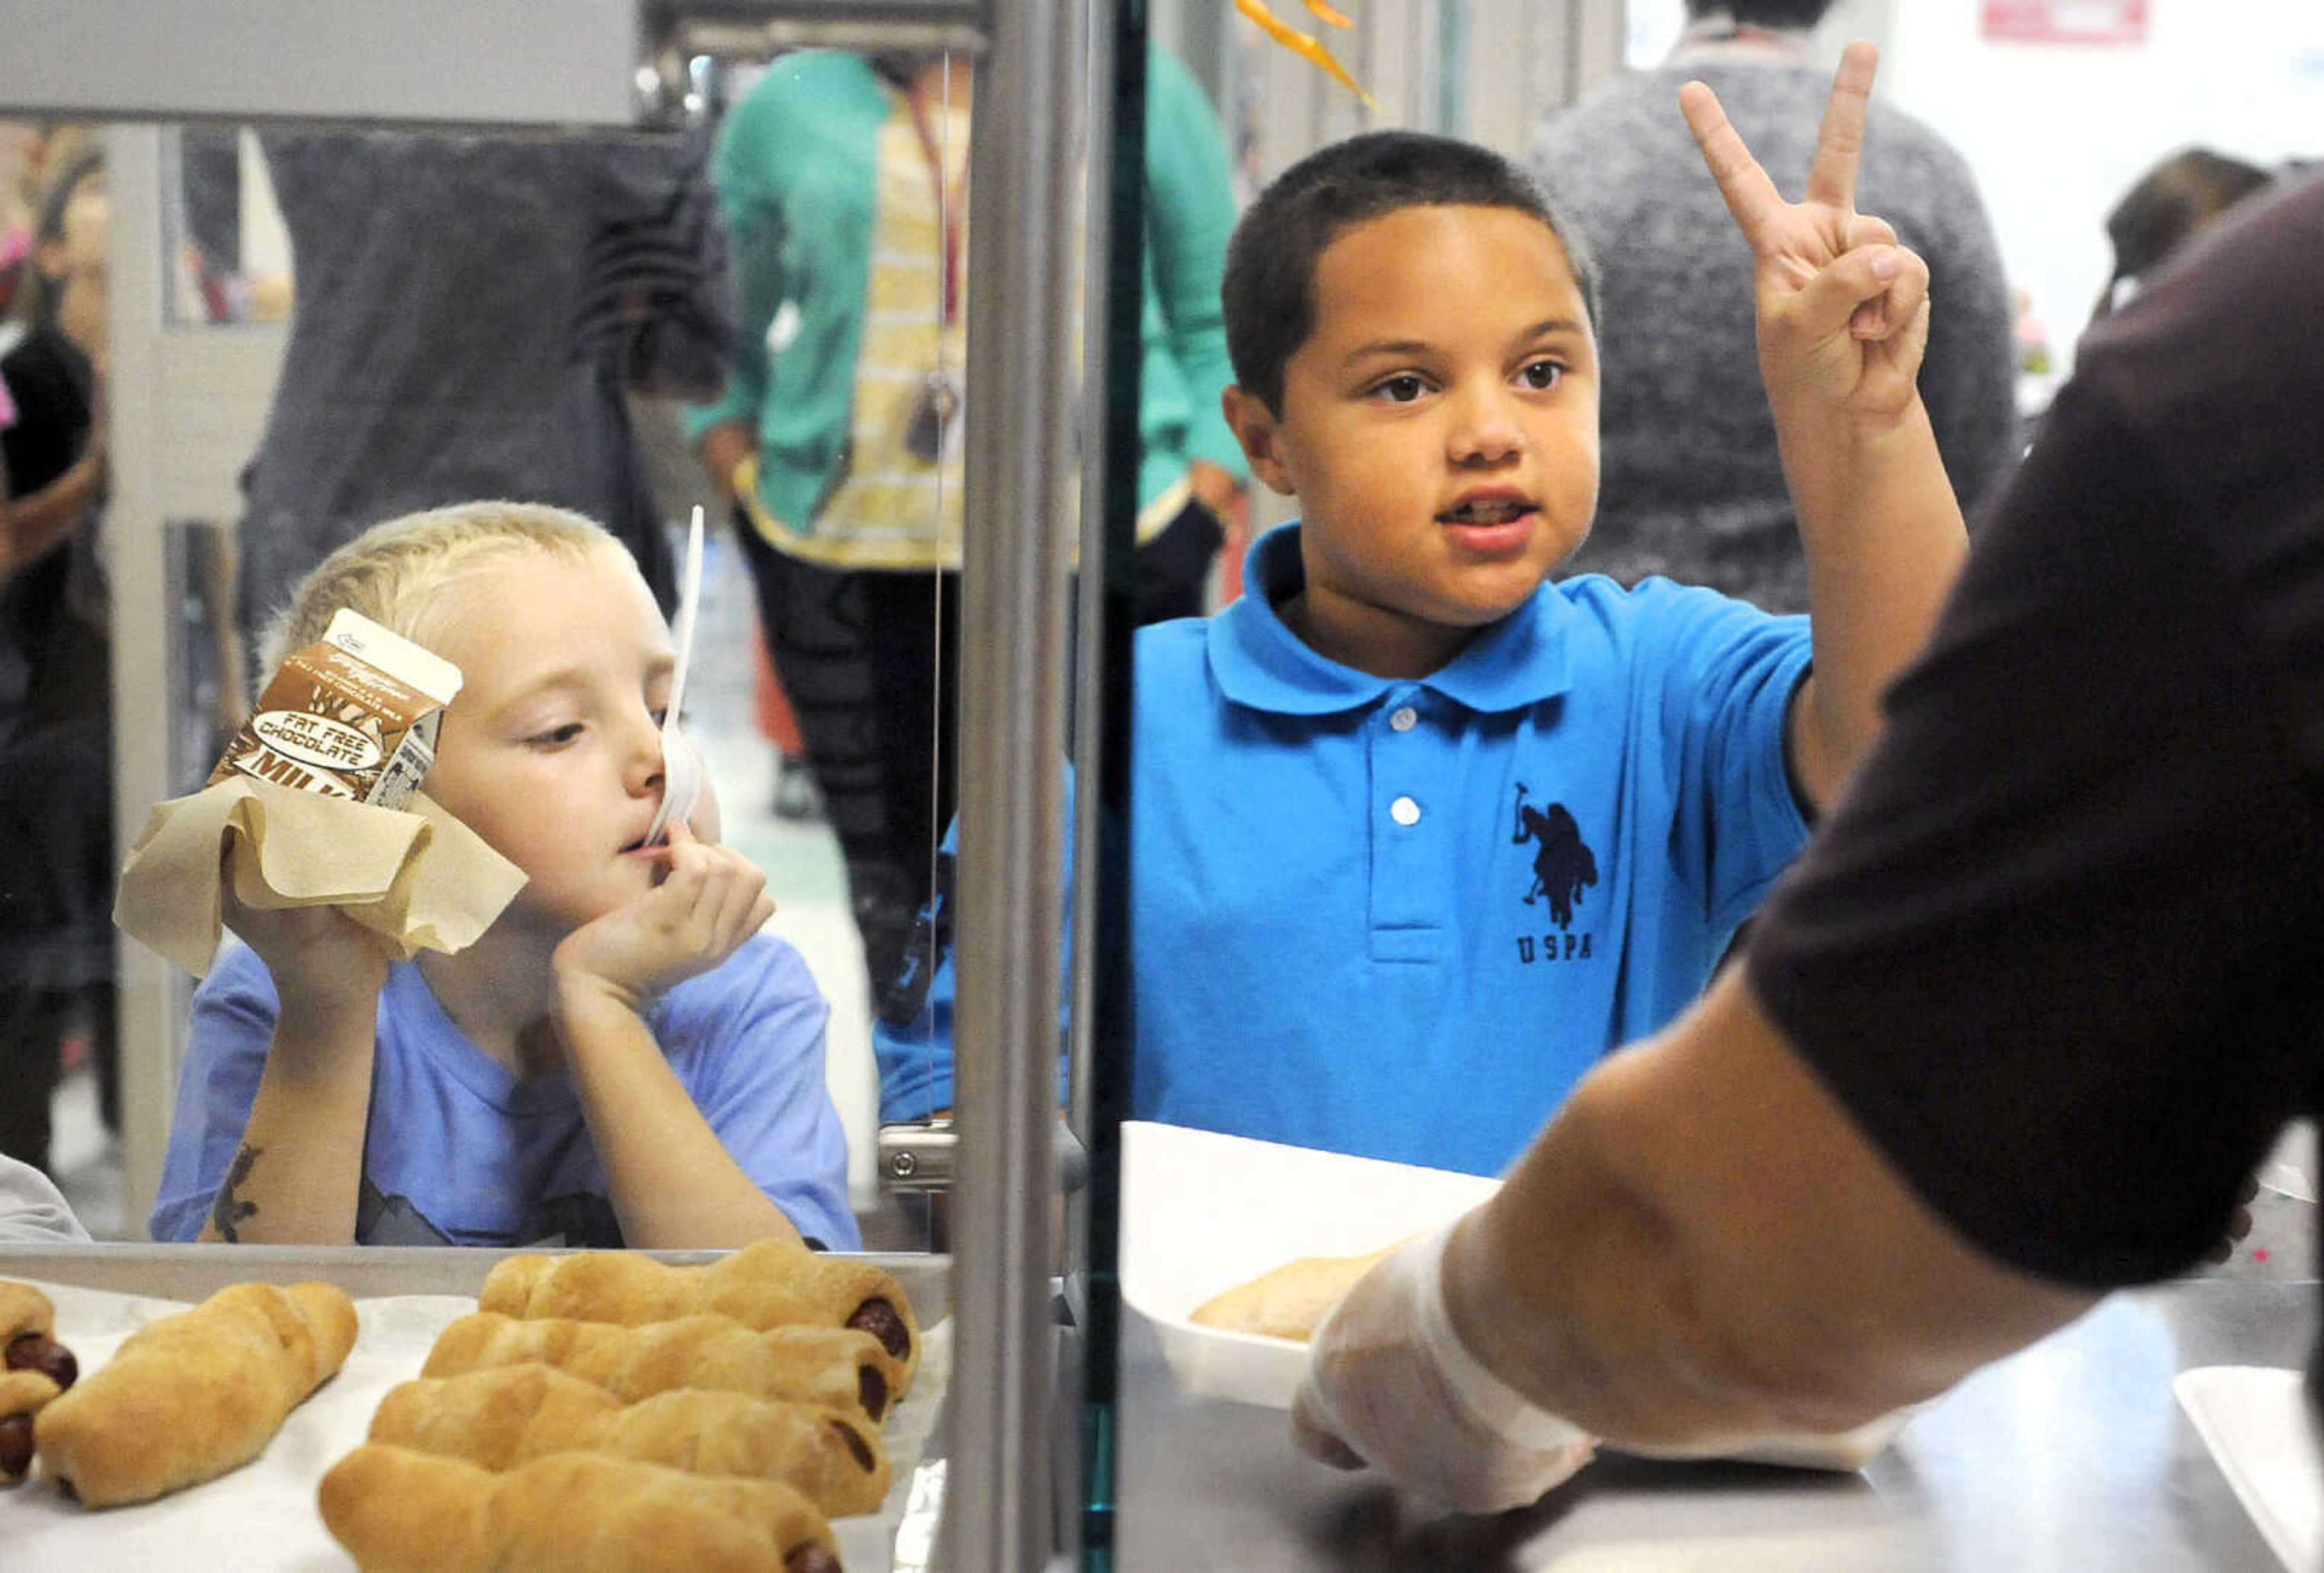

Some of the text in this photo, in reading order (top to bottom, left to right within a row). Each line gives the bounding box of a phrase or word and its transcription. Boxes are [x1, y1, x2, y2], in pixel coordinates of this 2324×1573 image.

[259, 721, 363, 766] CHOCOLATE
[283, 713, 368, 752] FAT FREE
